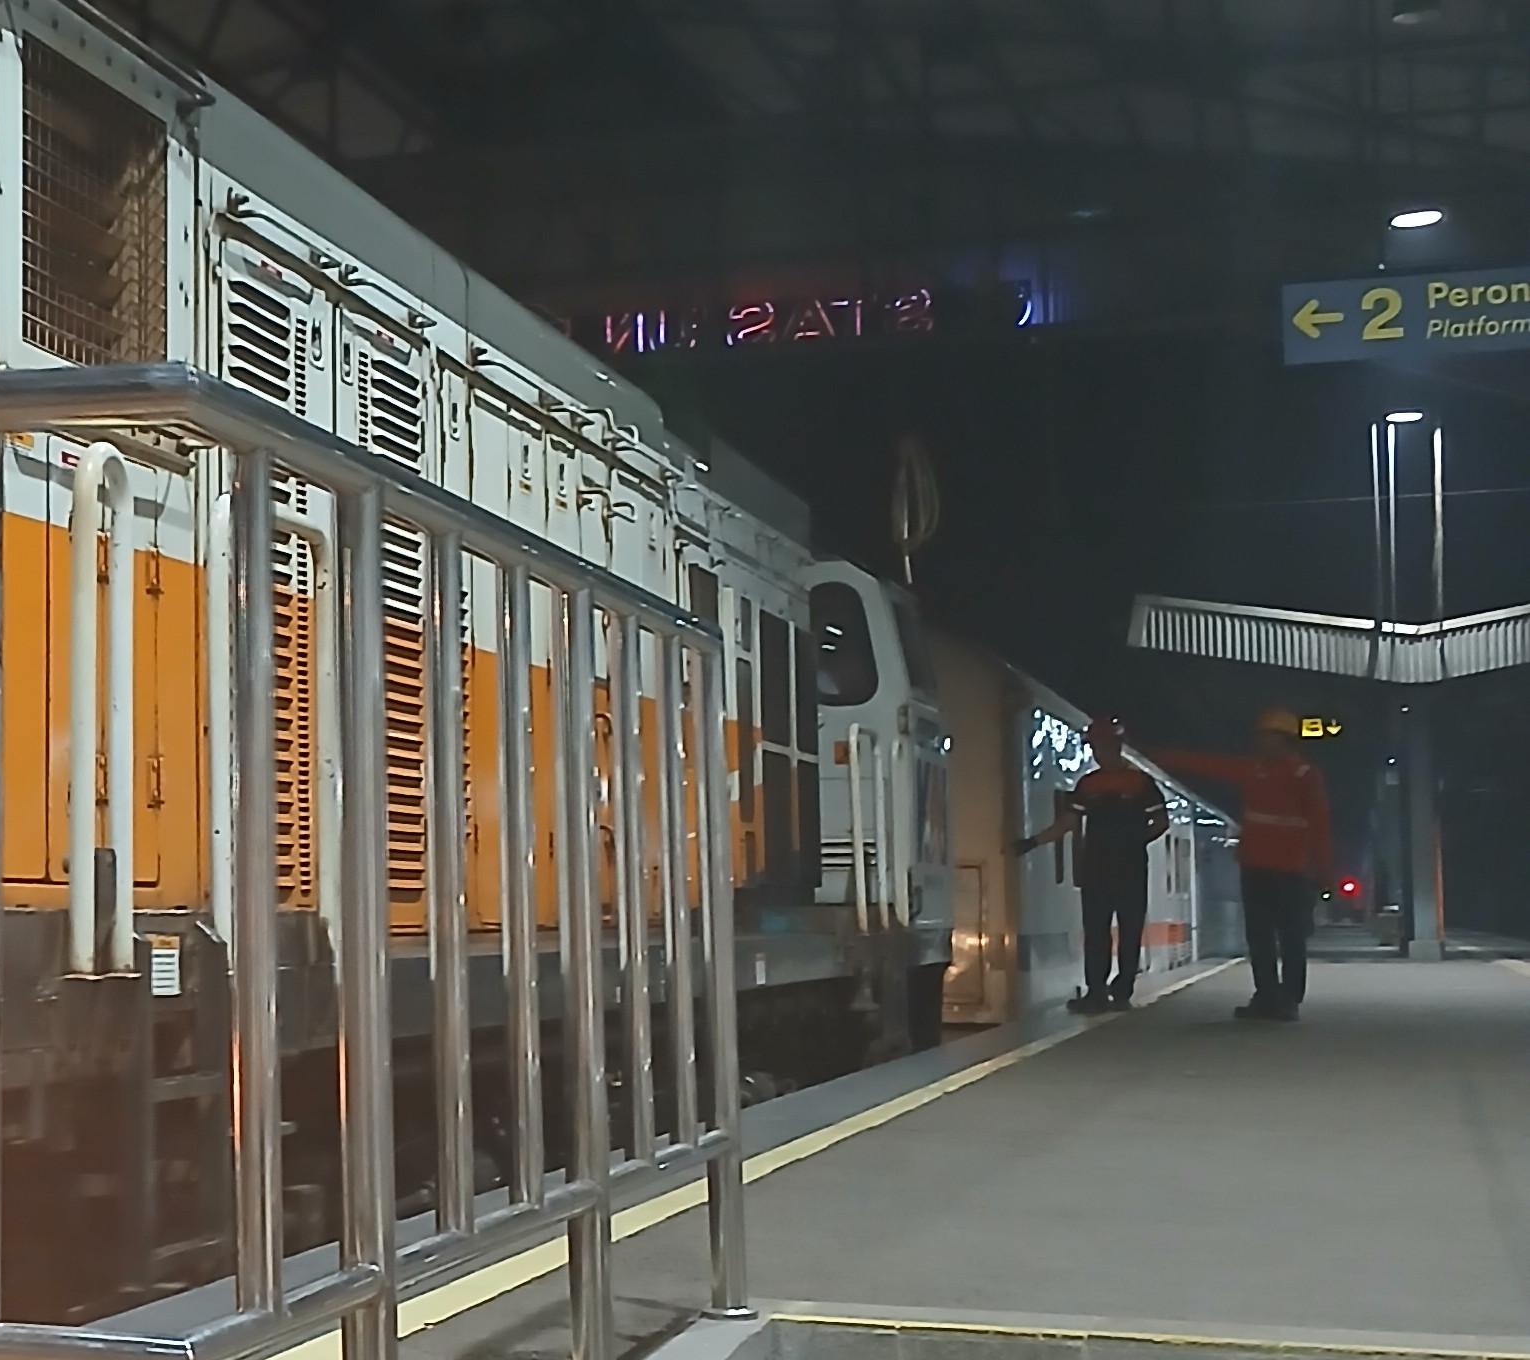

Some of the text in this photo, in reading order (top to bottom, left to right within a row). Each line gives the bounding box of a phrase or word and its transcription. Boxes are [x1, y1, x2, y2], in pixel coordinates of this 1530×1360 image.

[1427, 281, 1530, 309] Peron
[1361, 287, 1404, 340] 2
[1426, 315, 1530, 339] Platform
